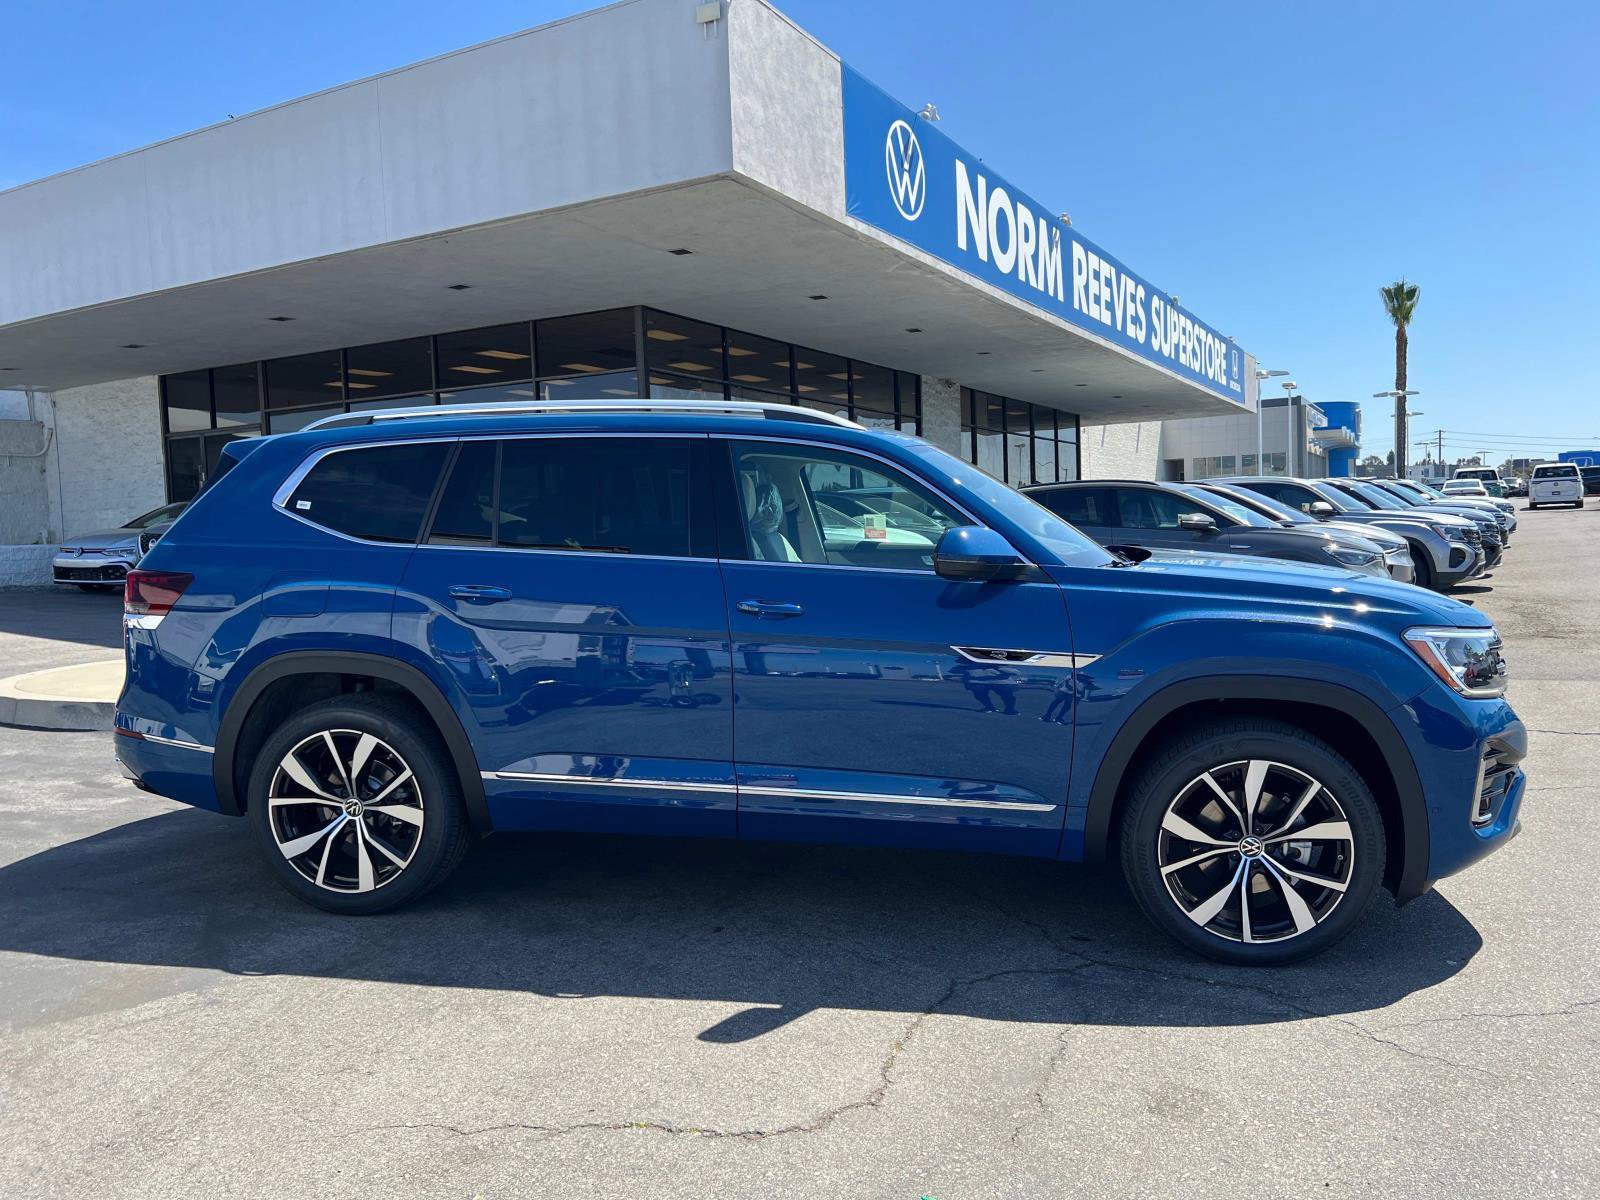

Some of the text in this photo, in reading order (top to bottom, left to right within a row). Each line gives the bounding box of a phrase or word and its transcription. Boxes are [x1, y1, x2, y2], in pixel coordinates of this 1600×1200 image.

[886, 120, 926, 221] VW
[956, 158, 1227, 386] NORM REEVES SUPERSTORE
